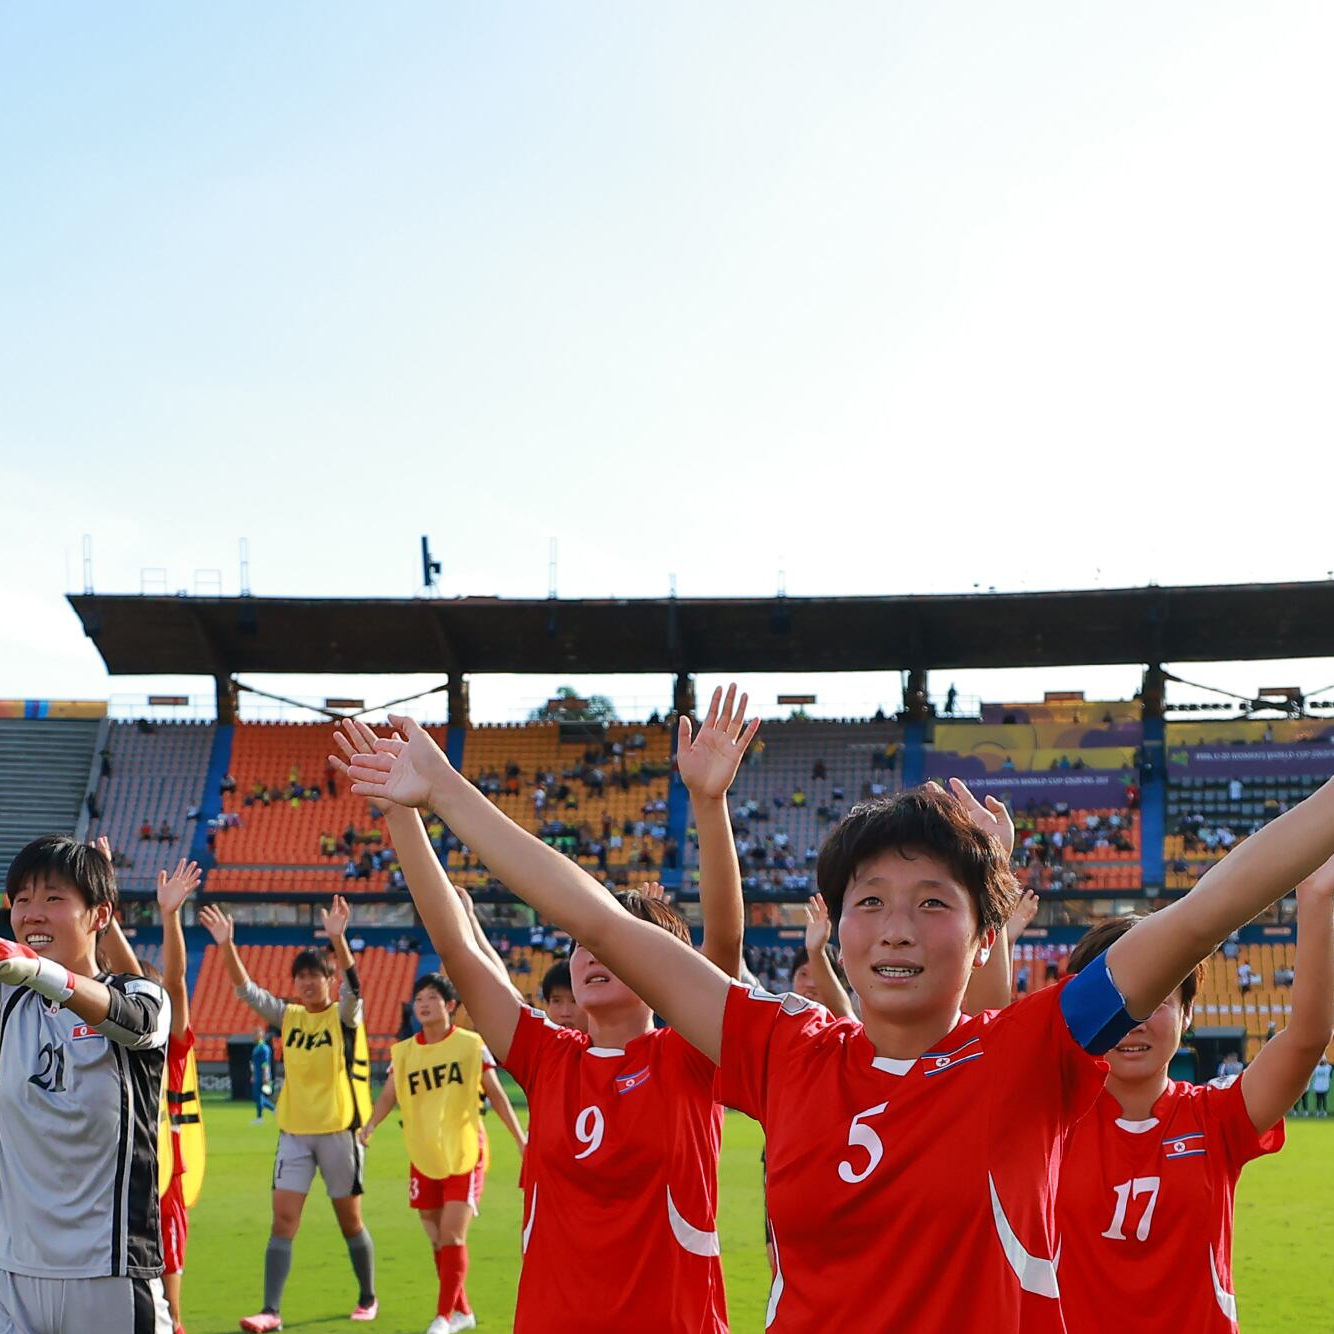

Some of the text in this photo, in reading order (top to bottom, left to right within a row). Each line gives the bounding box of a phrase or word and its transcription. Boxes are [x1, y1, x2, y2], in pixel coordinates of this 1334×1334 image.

[285, 1027, 333, 1051] FIFA
[28, 1042, 67, 1093] 21
[408, 1060, 464, 1096] FIFA
[574, 1105, 605, 1160] 9
[838, 1101, 889, 1184] 5
[1101, 1176, 1160, 1242] 17
